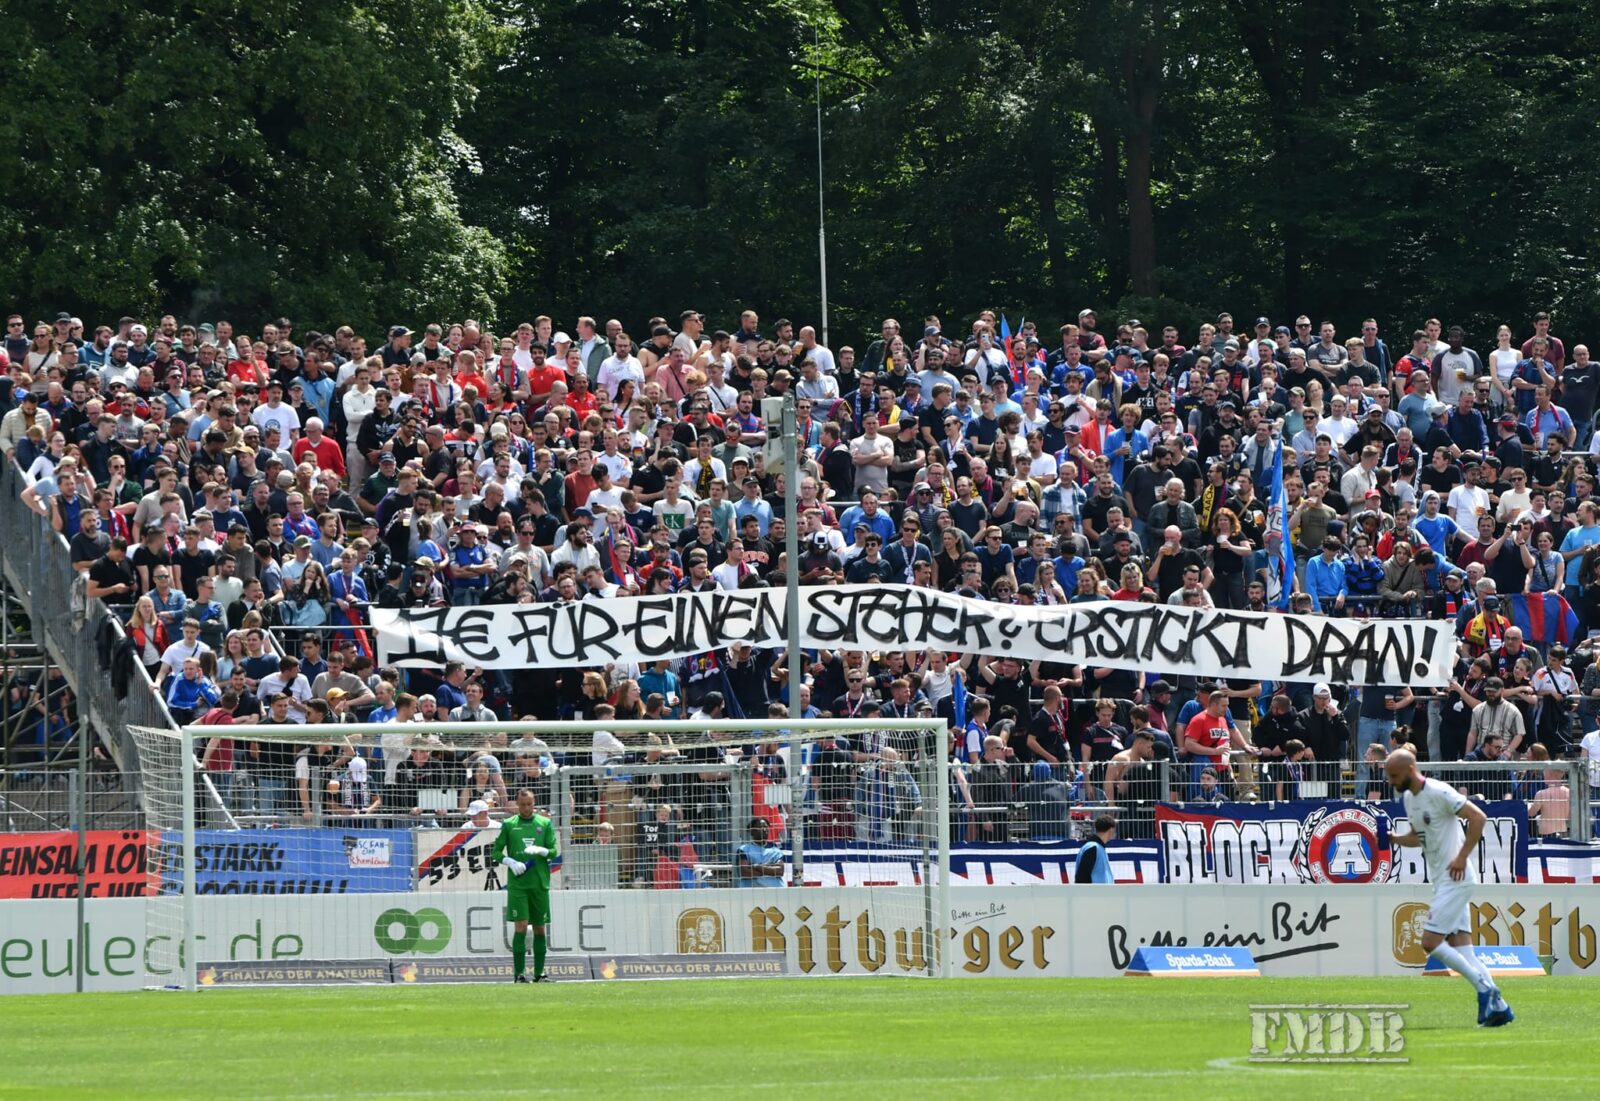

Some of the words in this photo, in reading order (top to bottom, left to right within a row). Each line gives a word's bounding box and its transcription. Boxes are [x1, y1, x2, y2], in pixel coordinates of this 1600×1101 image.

[508, 602, 622, 663] FÜR
[622, 591, 788, 656] EINEN
[1280, 616, 1438, 686] DRAN!
[1160, 821, 1303, 884] BLOCK
[1329, 832, 1371, 875] A
[1272, 902, 1340, 942] Bit
[622, 964, 683, 974] FINALTAG
[686, 963, 711, 973] DER
[714, 962, 781, 972] AMATEURE
[1166, 953, 1235, 970] Sparda-Bank
[222, 969, 285, 981] FINALTAG
[287, 969, 312, 980] DER
[316, 968, 384, 979] AMATEURE
[423, 966, 485, 976] FINALTAG
[488, 966, 513, 975] DER
